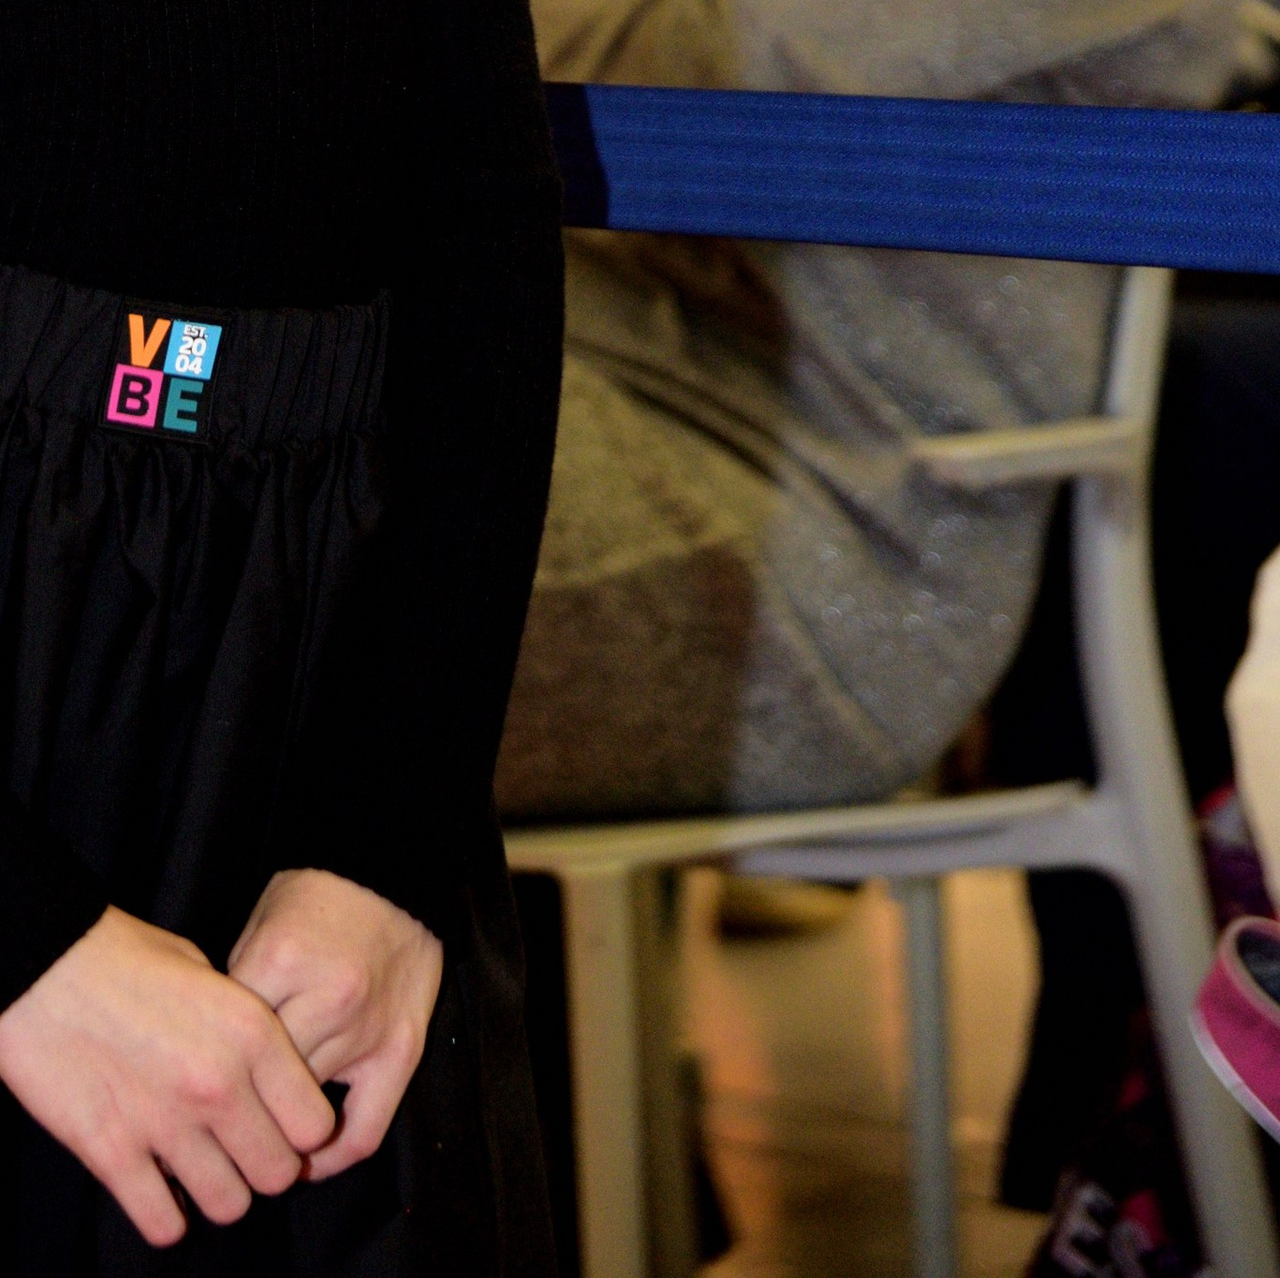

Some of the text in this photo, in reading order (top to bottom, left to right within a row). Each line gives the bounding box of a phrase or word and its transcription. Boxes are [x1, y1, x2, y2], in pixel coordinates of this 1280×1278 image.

[183, 324, 208, 338] EST.
[178, 336, 207, 357] 20
[175, 354, 202, 375] 04
